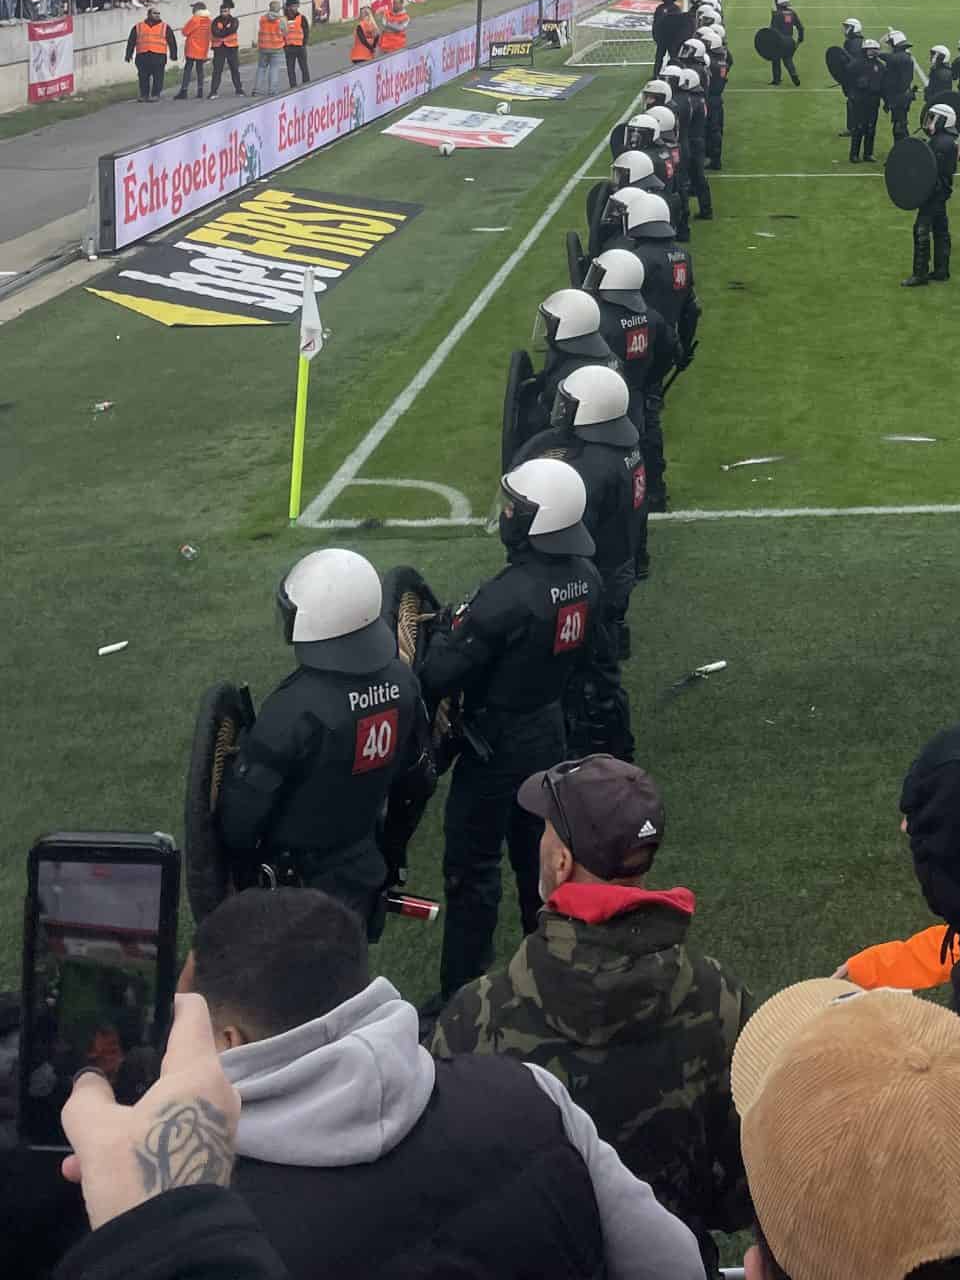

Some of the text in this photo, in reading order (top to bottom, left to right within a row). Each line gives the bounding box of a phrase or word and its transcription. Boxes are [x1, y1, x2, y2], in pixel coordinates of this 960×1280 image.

[278, 102, 306, 152] Écht
[307, 92, 336, 147] goeie
[123, 160, 168, 224] Écht
[171, 144, 216, 216] goeie
[117, 188, 408, 315] betFIRST
[550, 579, 589, 605] Politie
[560, 611, 582, 644] 40
[349, 682, 400, 711] Politie
[362, 720, 392, 761] 40
